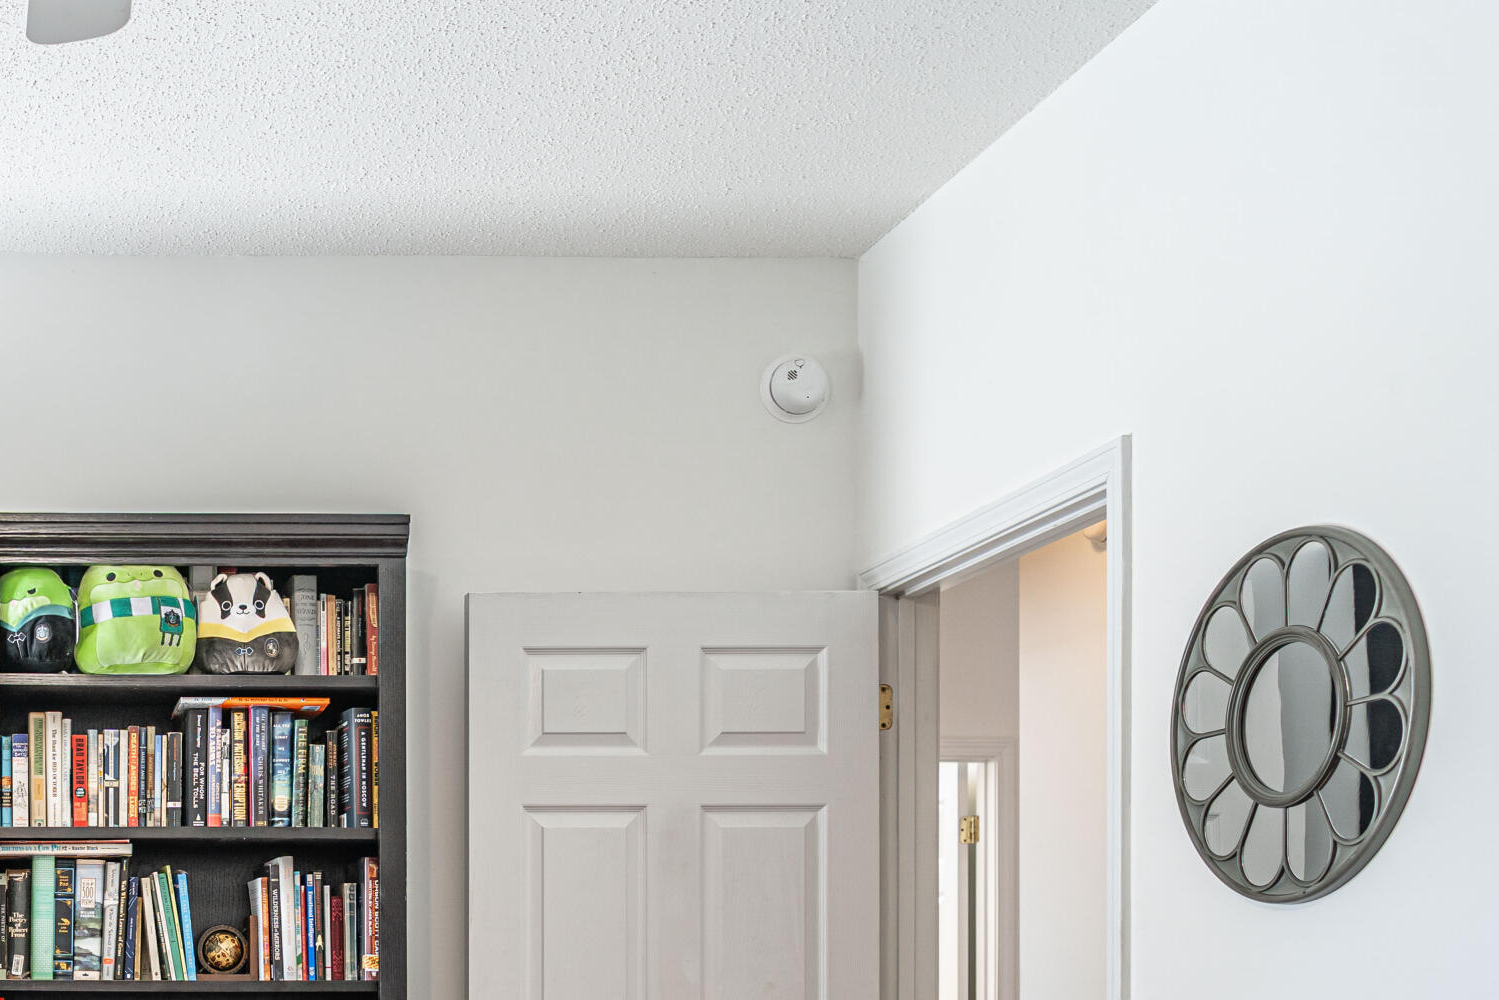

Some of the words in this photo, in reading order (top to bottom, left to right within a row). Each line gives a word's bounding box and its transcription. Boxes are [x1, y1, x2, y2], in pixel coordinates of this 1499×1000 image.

[234, 712, 243, 740] CRICHTON
[299, 727, 307, 747] THE
[76, 759, 84, 784] TAYLOR
[234, 744, 243, 774] PATTERSON
[298, 750, 306, 773] FIRM
[234, 783, 245, 820] ERUPTION
